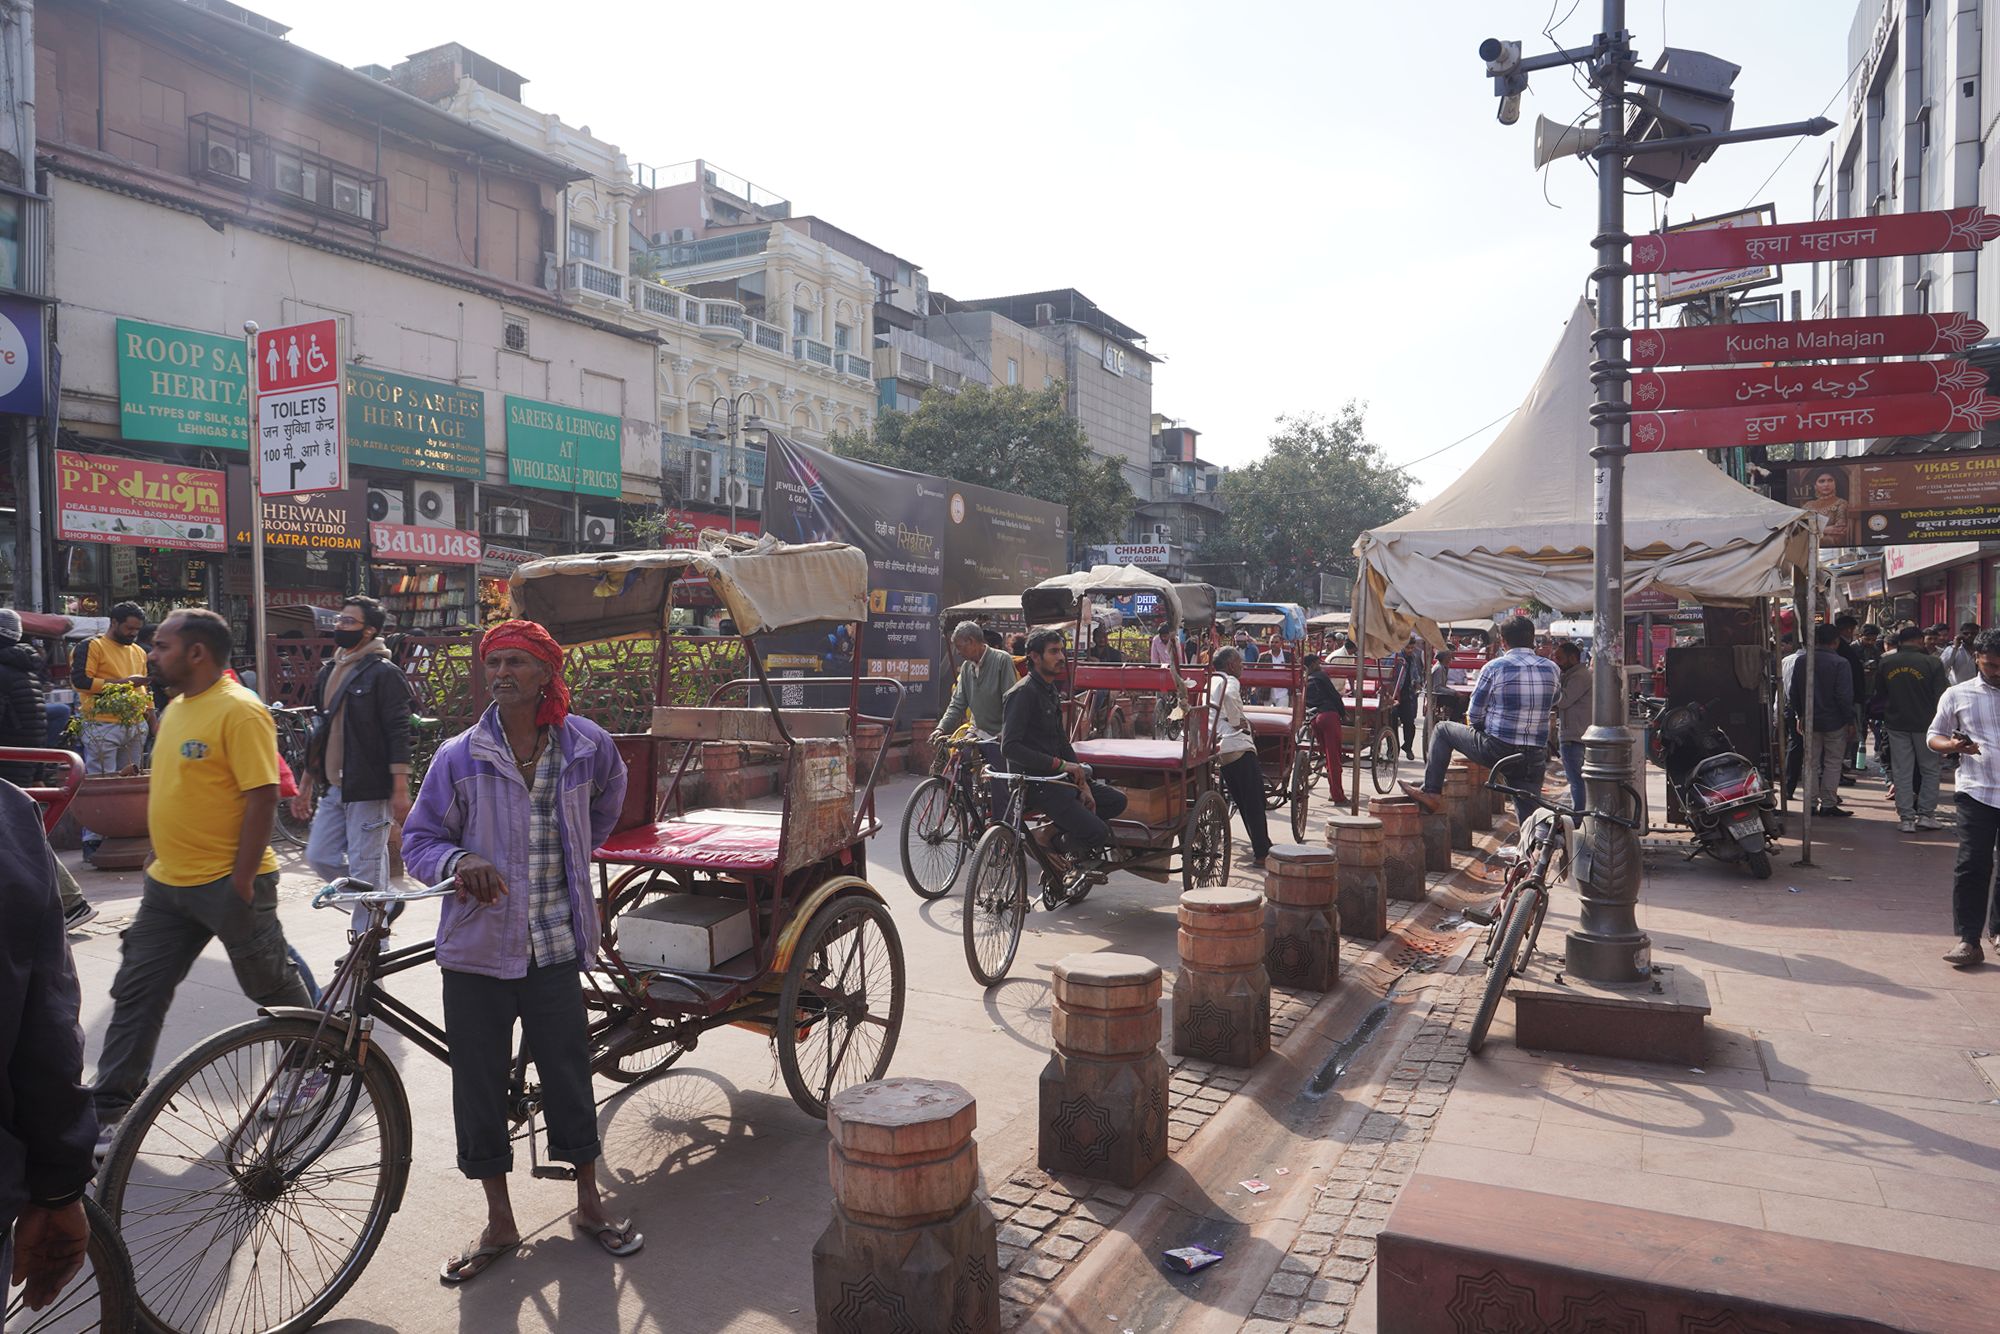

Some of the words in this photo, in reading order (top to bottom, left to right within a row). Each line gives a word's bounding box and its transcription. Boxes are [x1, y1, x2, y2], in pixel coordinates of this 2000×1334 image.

[1745, 235, 1792, 260] कूचा
[1800, 228, 1878, 251] महाजन
[1726, 334, 1789, 351] Kucha
[1796, 330, 1885, 350] Mahajan
[125, 332, 204, 368] ROOP
[346, 377, 403, 403] ROOP
[409, 388, 479, 418] SAREES
[124, 402, 146, 415] ALL
[149, 405, 185, 419] TYPES
[187, 410, 202, 421] OF
[204, 412, 231, 427] SILK,
[271, 396, 326, 419] TOILETS
[177, 422, 228, 438] LEHNGAS
[230, 429, 239, 439] &
[262, 425, 279, 438] जन
[283, 418, 311, 441] सुविधा
[315, 415, 335, 433] केन्द्र
[363, 405, 466, 439] HERITAGE
[511, 406, 554, 430] SAREES
[555, 414, 564, 433] &
[565, 415, 616, 441] LEHNGAS
[263, 448, 281, 462] 100
[283, 443, 296, 460] मी.
[301, 440, 320, 457] आगे
[559, 441, 574, 458] AT
[61, 455, 119, 473] Kapoor
[1914, 461, 1960, 473] VIKAS
[511, 458, 581, 485] WHOLESALE
[582, 468, 618, 490] PRICES
[65, 502, 97, 512] DEALS
[109, 507, 142, 517] BRIDAL
[144, 510, 169, 519] BAGS
[169, 512, 187, 521] AND
[131, 498, 179, 511] Footwear
[200, 505, 220, 514] Mall
[303, 522, 346, 535] STUDIO
[1915, 520, 1947, 531] कूचा
[64, 531, 88, 540] SHOP
[90, 533, 106, 541] NO.
[266, 532, 308, 546] KATRA
[311, 535, 361, 549] CHOBAN
[373, 528, 481, 558] BALUJAS
[1114, 546, 1167, 555] CHHABRA
[1136, 595, 1158, 604] DHIR
[871, 661, 882, 673] 28
[910, 664, 929, 676] 2026
